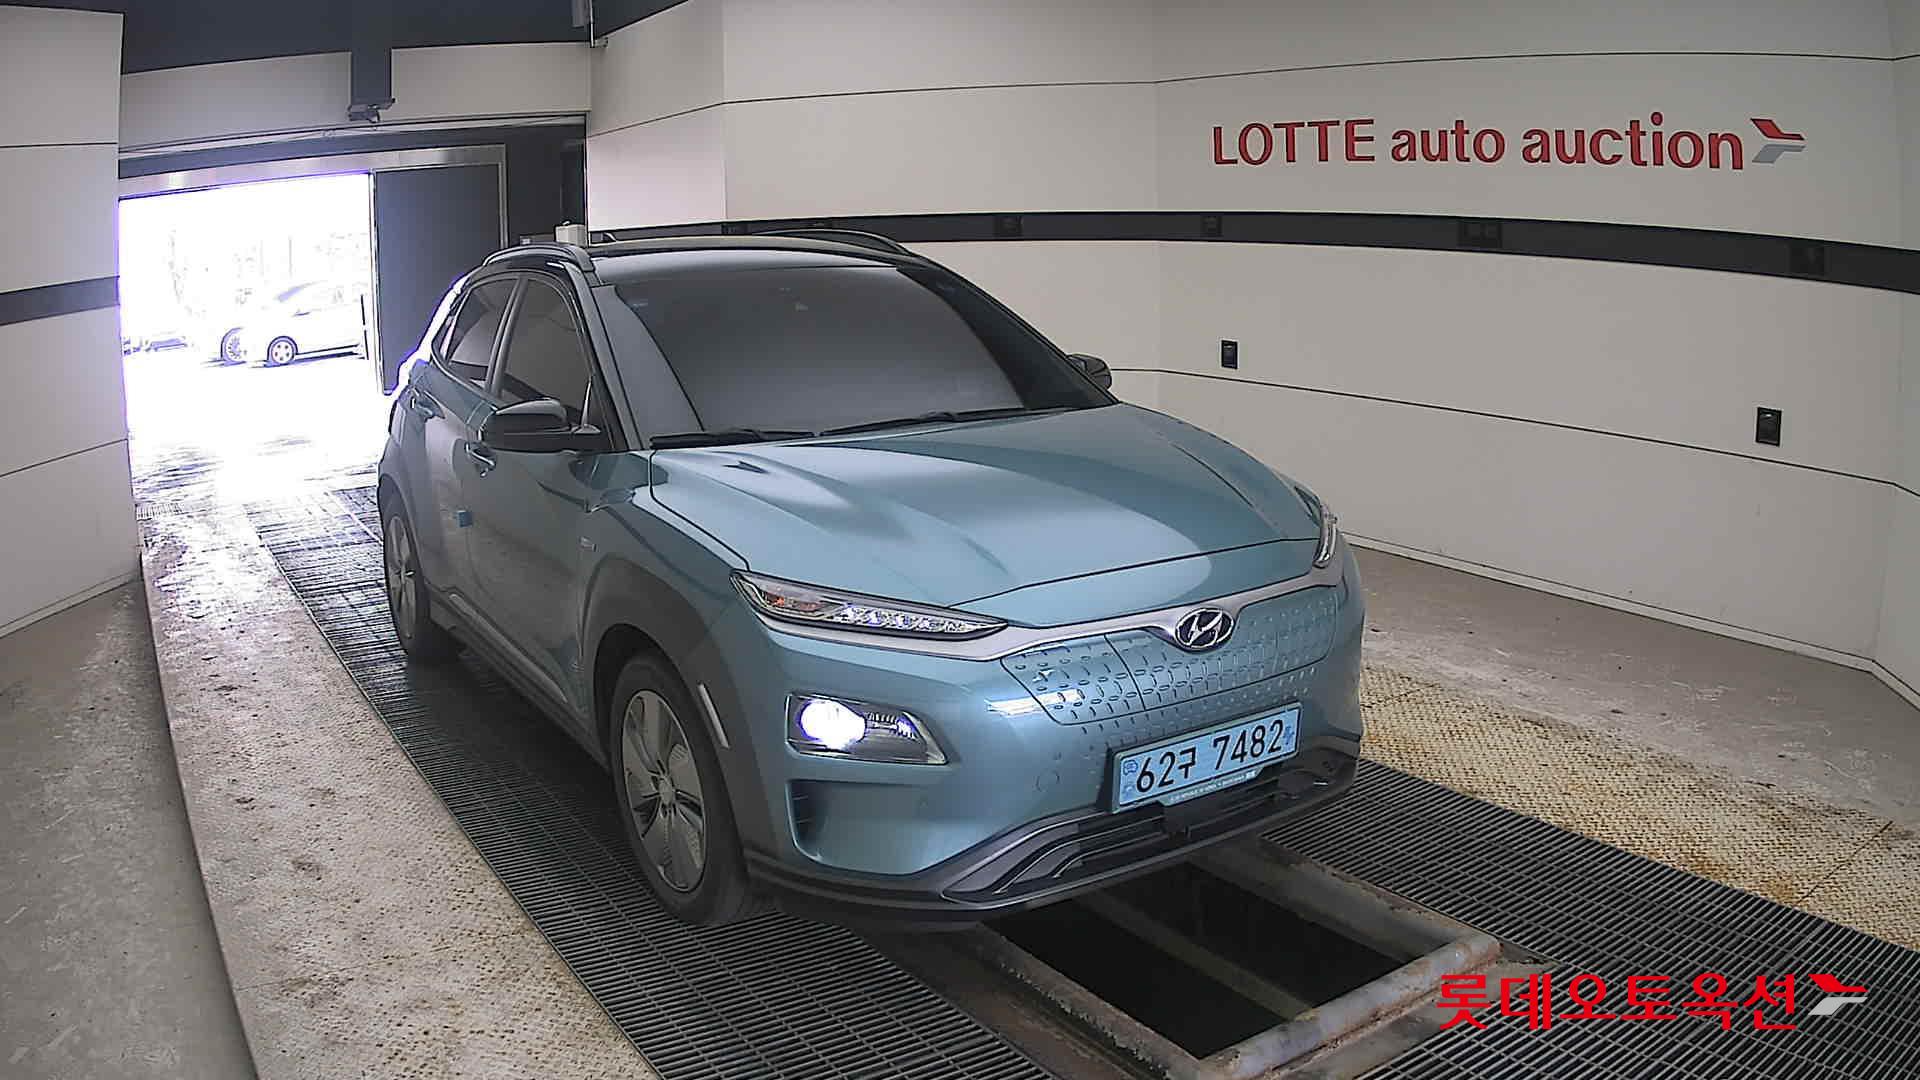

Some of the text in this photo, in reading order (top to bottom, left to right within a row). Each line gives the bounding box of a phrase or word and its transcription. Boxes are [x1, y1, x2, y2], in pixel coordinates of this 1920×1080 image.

[1213, 111, 1744, 170] LOTTE auto auction
[1136, 747, 1197, 793] 62구
[1213, 719, 1284, 771] 7482
